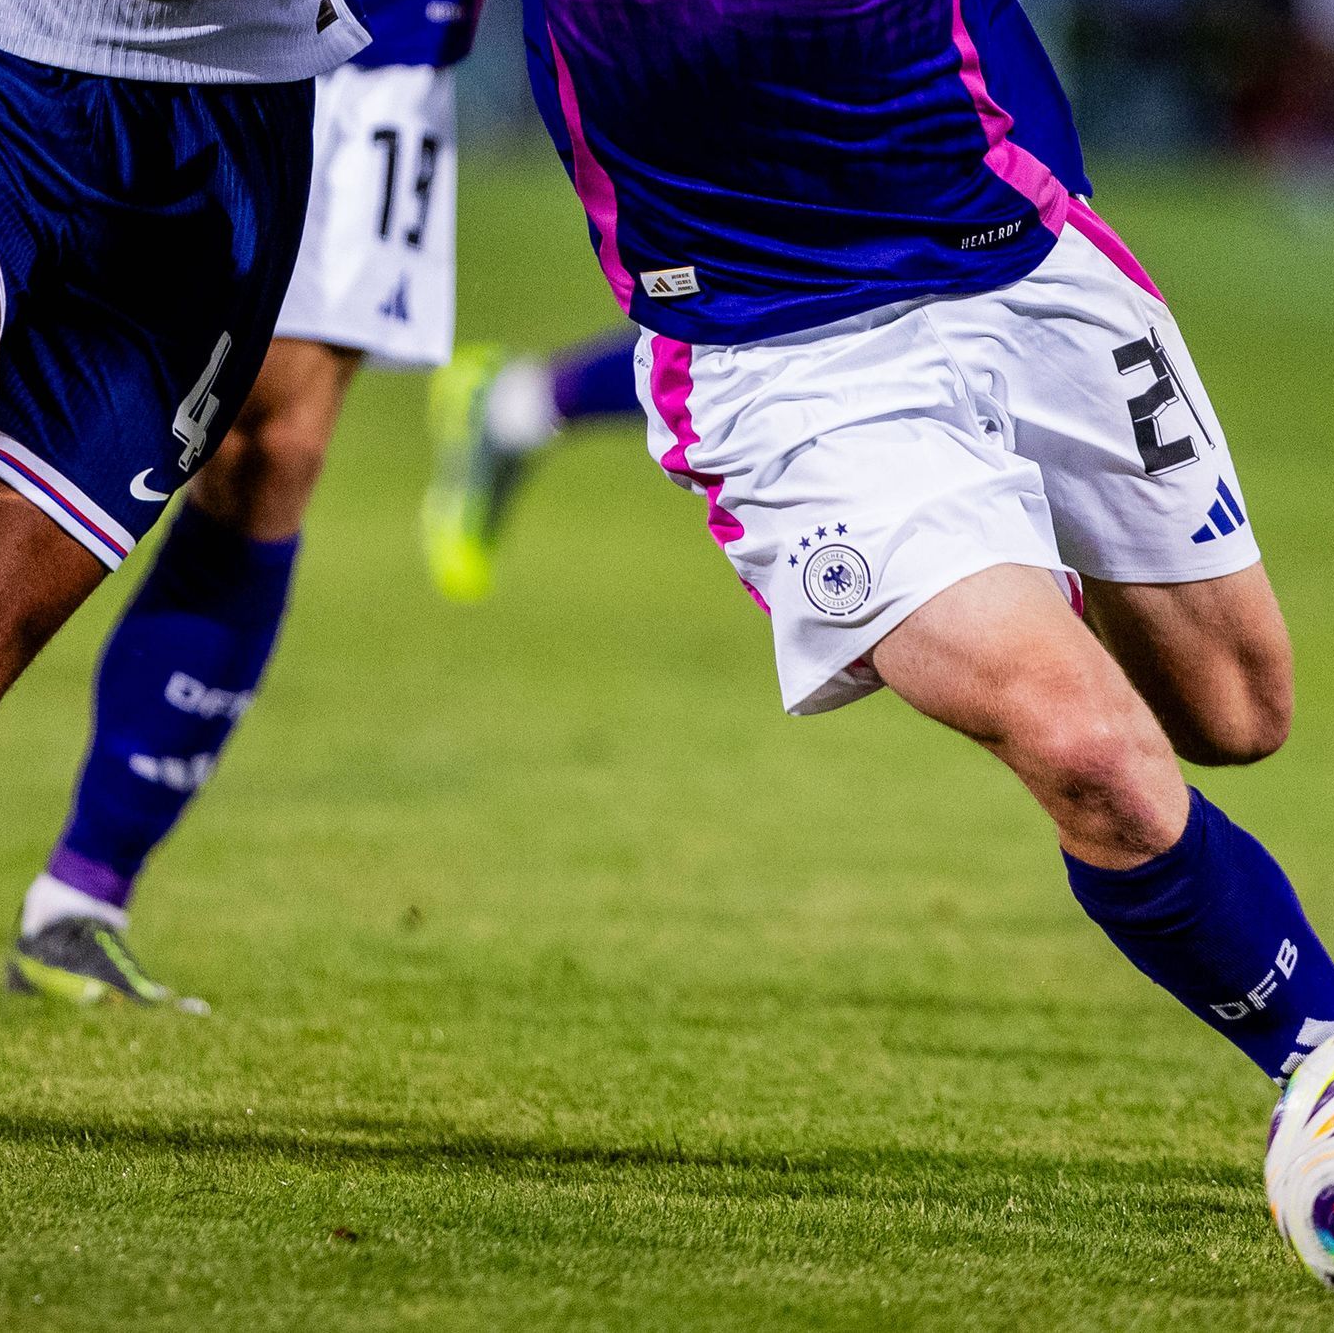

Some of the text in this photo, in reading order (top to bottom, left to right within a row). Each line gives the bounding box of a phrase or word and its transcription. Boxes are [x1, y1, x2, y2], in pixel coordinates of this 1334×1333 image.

[961, 220, 1022, 250] HEAT.RDY
[172, 330, 232, 472] 4
[1111, 326, 1216, 477] 21
[811, 553, 845, 578] DEUTSCHER
[1209, 937, 1298, 1020] DFB
